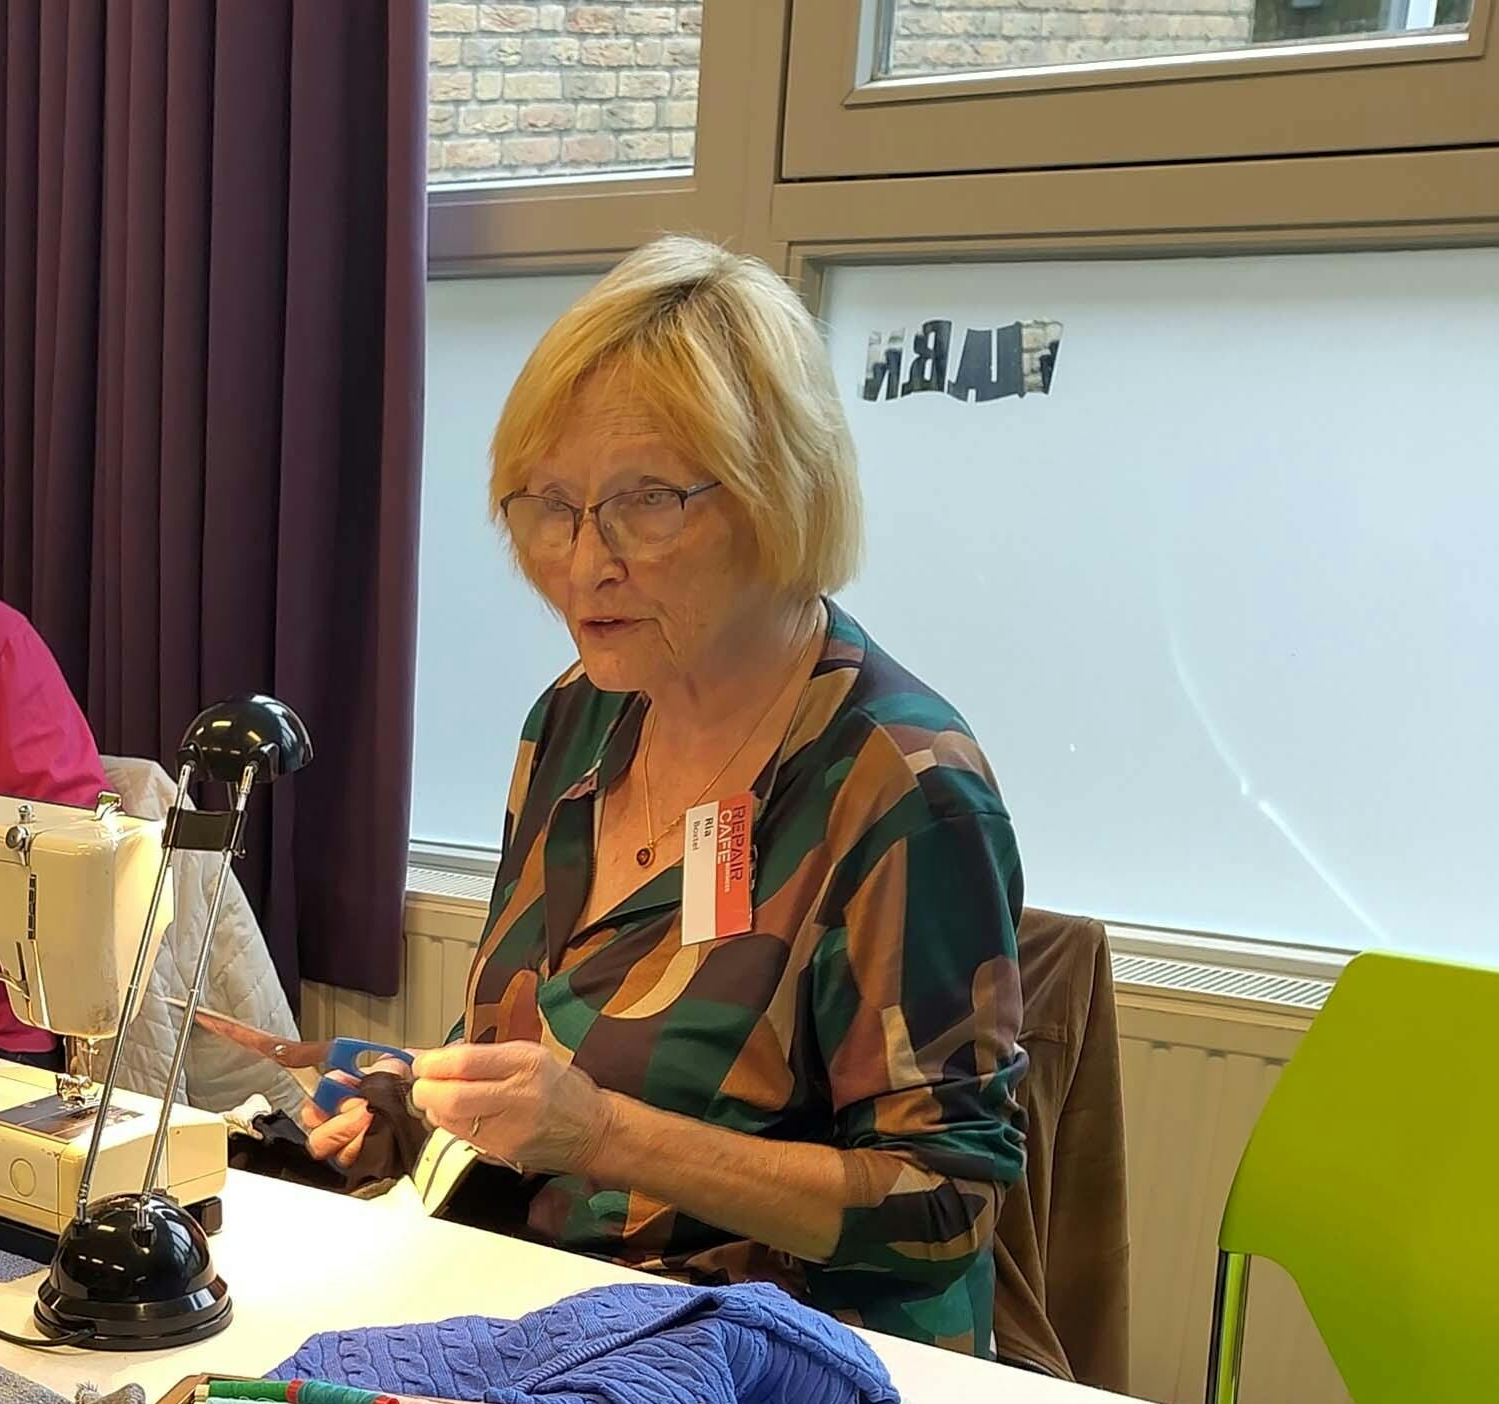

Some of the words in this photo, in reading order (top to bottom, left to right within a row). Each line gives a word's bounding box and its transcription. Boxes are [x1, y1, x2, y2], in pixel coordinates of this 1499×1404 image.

[704, 816, 713, 838] Ria
[718, 809, 733, 865] CAFE
[731, 805, 746, 881] REPAIR
